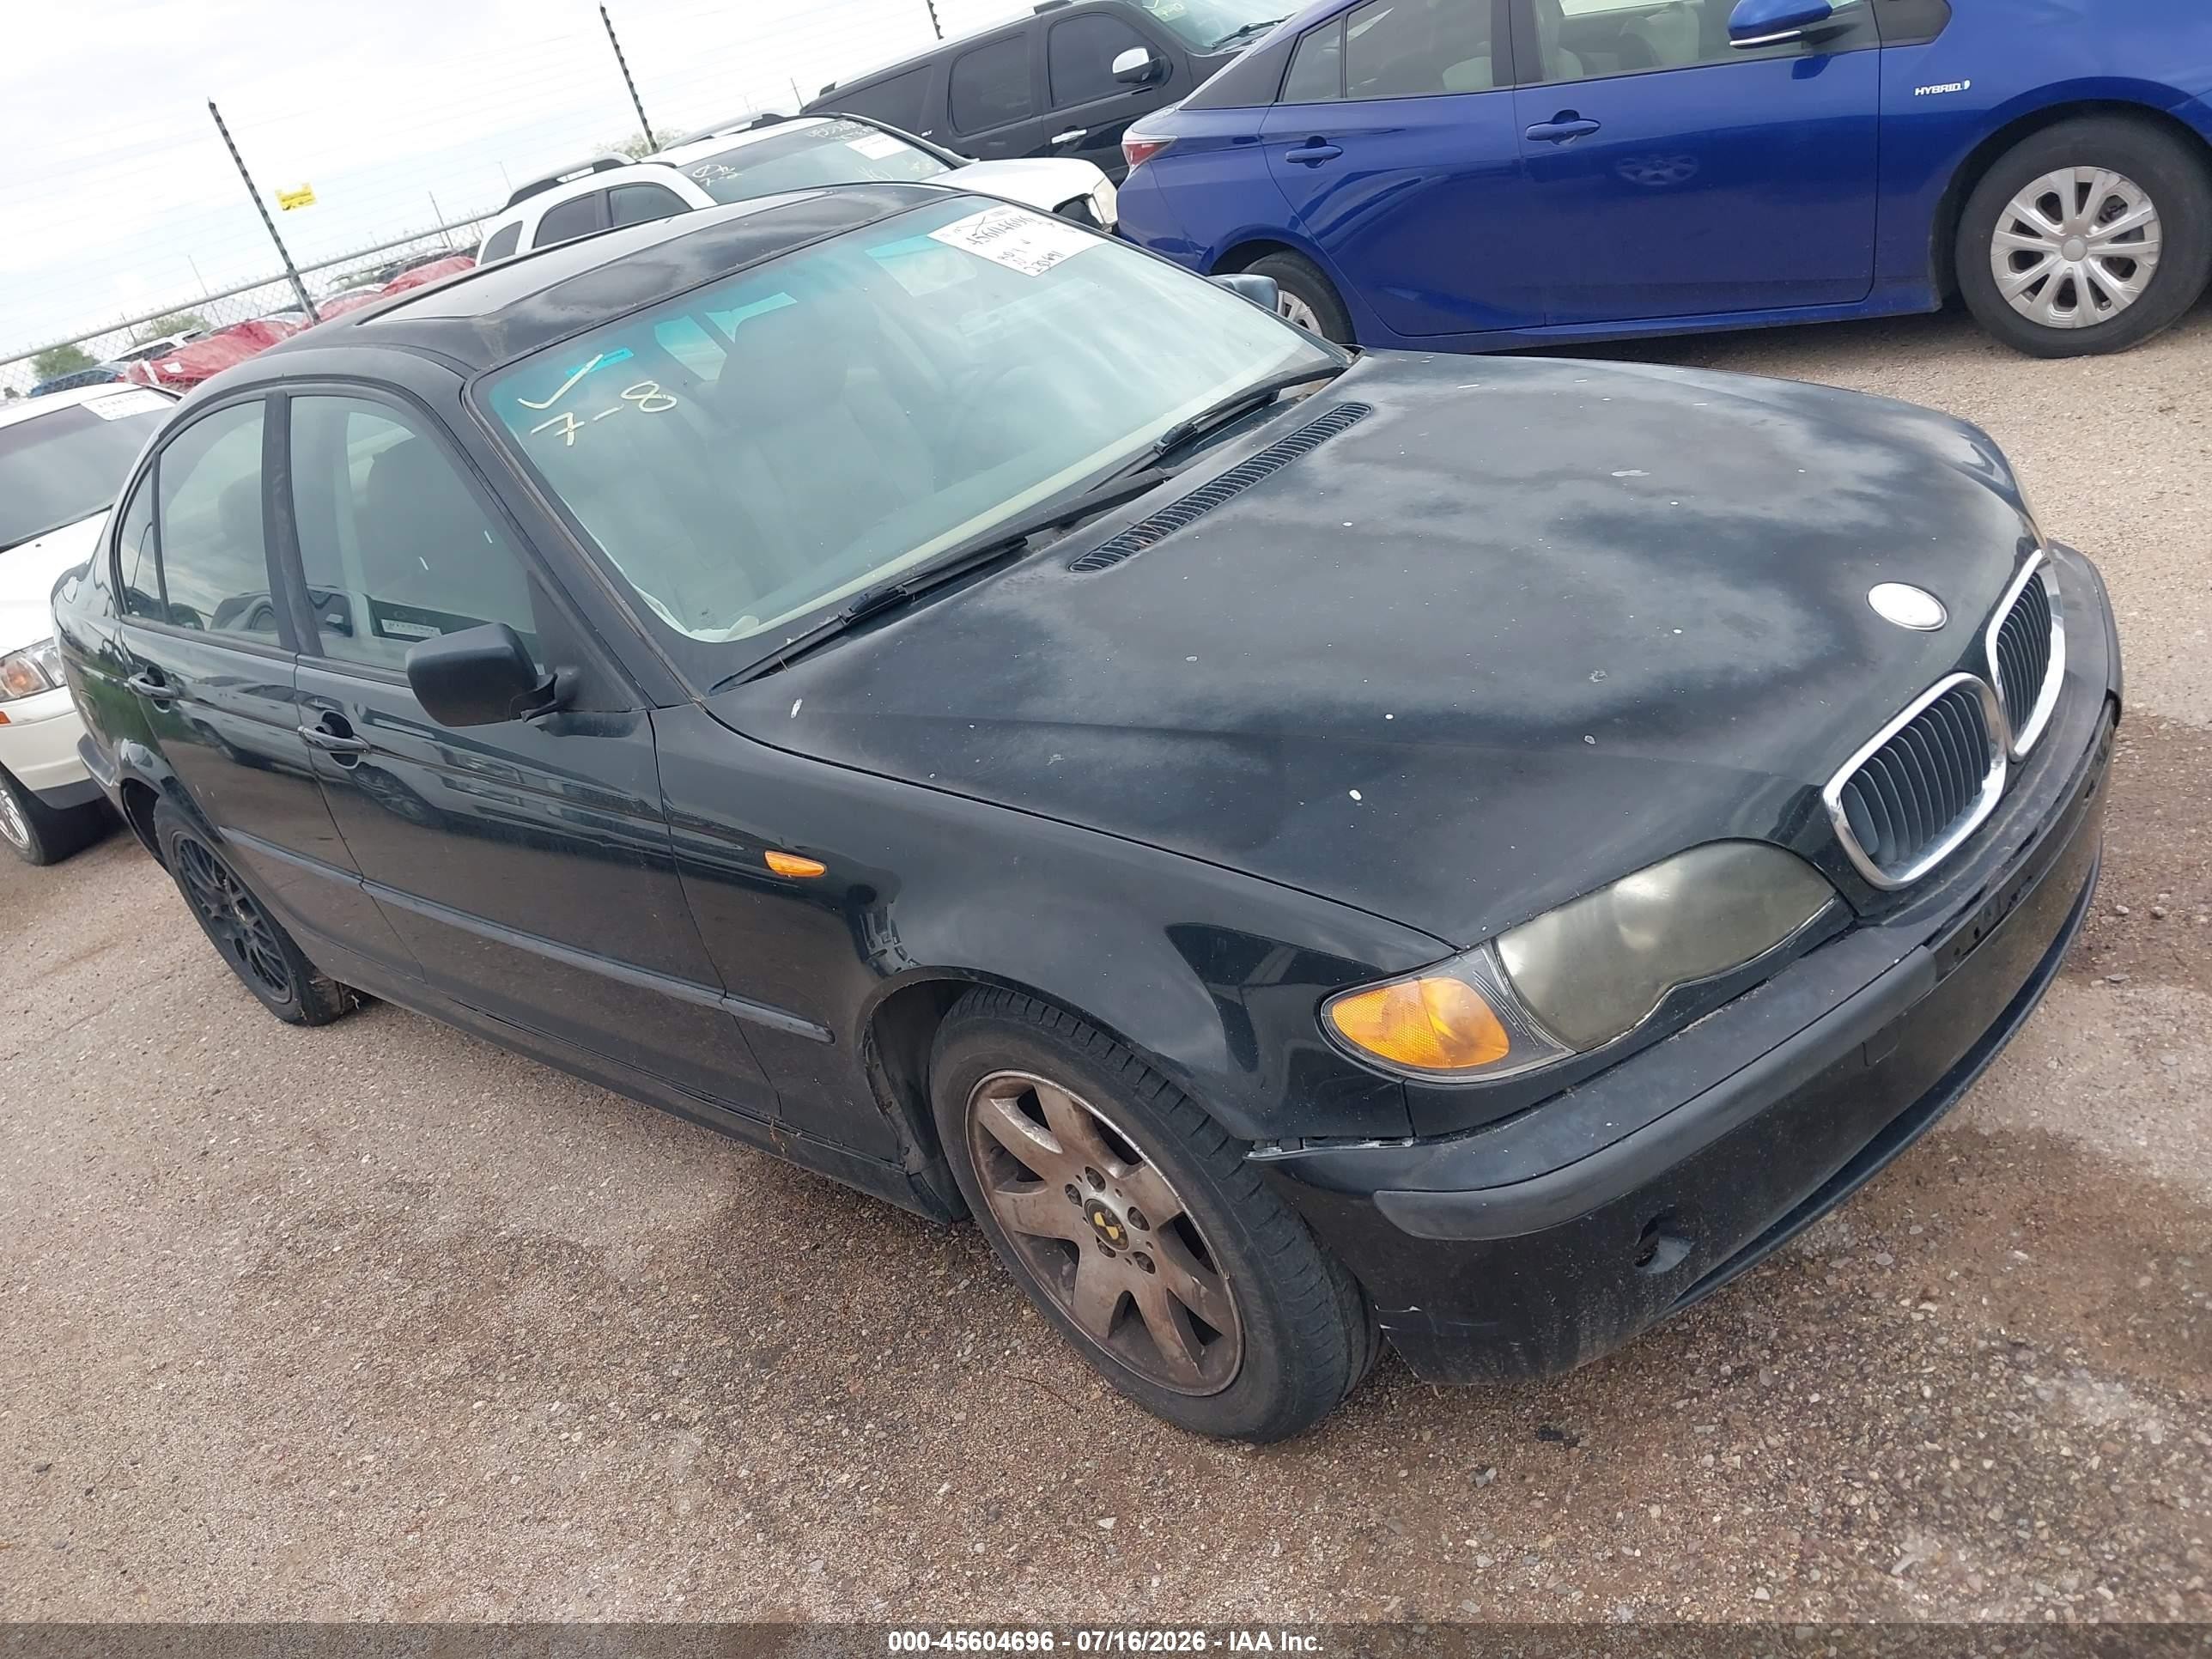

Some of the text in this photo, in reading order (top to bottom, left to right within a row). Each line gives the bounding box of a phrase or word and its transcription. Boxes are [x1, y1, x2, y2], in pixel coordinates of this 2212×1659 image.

[1914, 82, 1963, 96] HYBRID
[966, 216, 1036, 245] 45604696
[531, 380, 678, 446] 7-8
